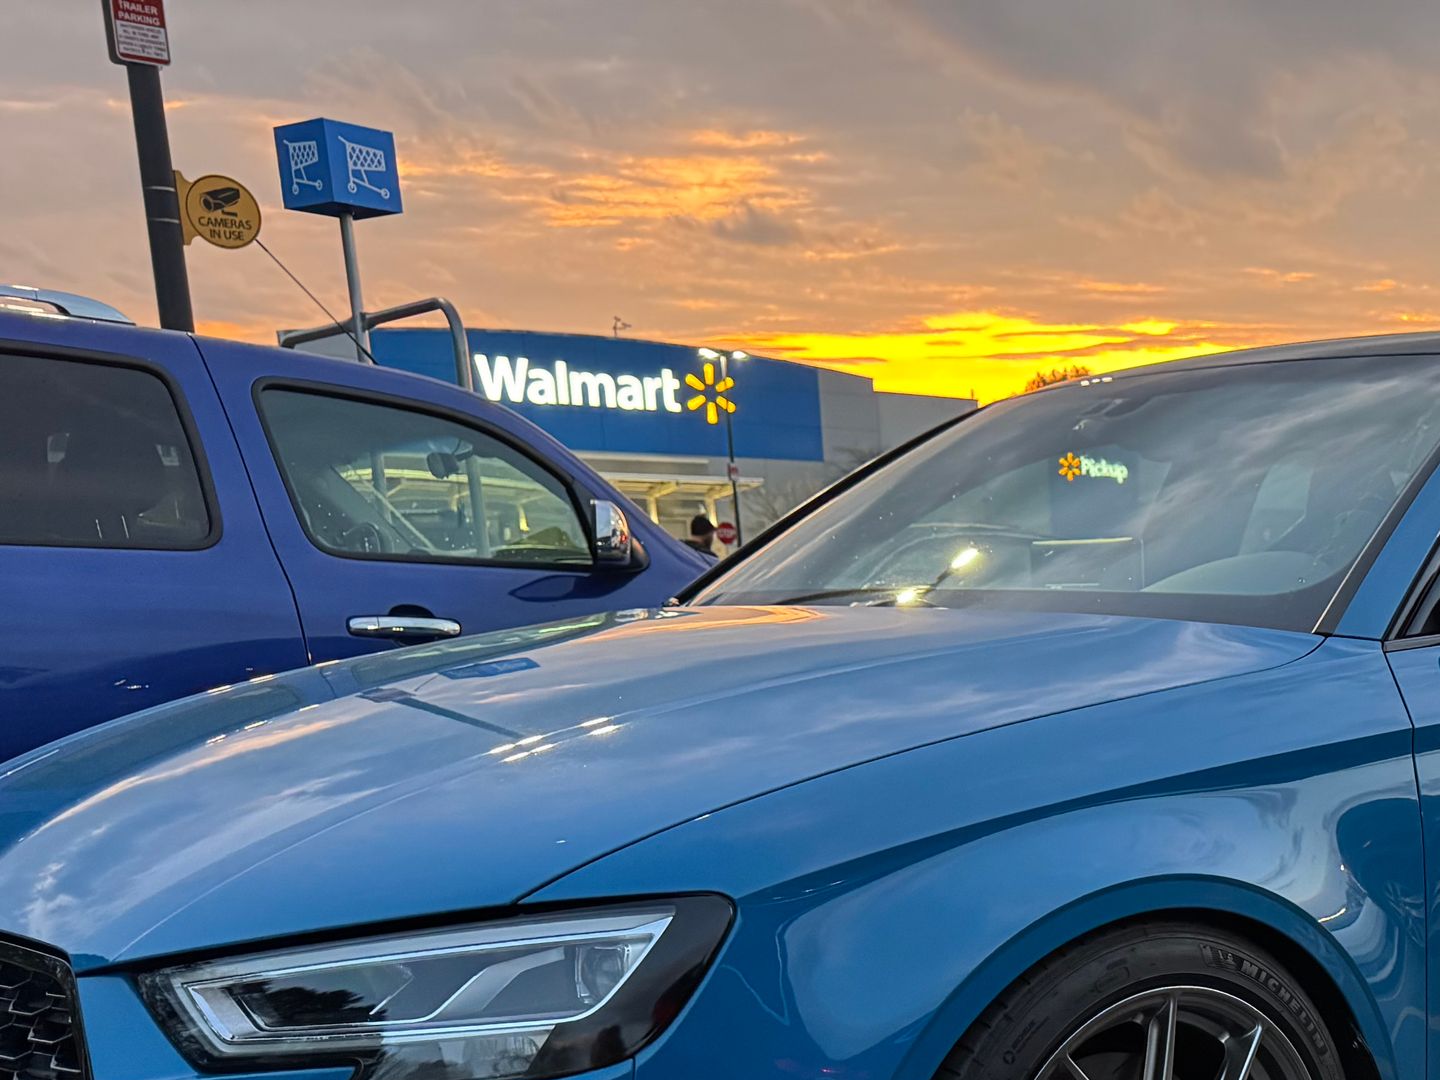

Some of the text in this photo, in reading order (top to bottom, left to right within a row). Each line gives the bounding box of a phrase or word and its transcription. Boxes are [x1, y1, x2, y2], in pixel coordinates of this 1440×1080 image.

[119, 0, 158, 15] TRAILER
[118, 10, 160, 26] PARKING
[198, 216, 252, 230] CAMERAS
[209, 229, 244, 241] IN USE
[474, 353, 682, 413] Walmart
[1080, 455, 1128, 484] Pickup
[1240, 959, 1325, 1049] MICHELIN
